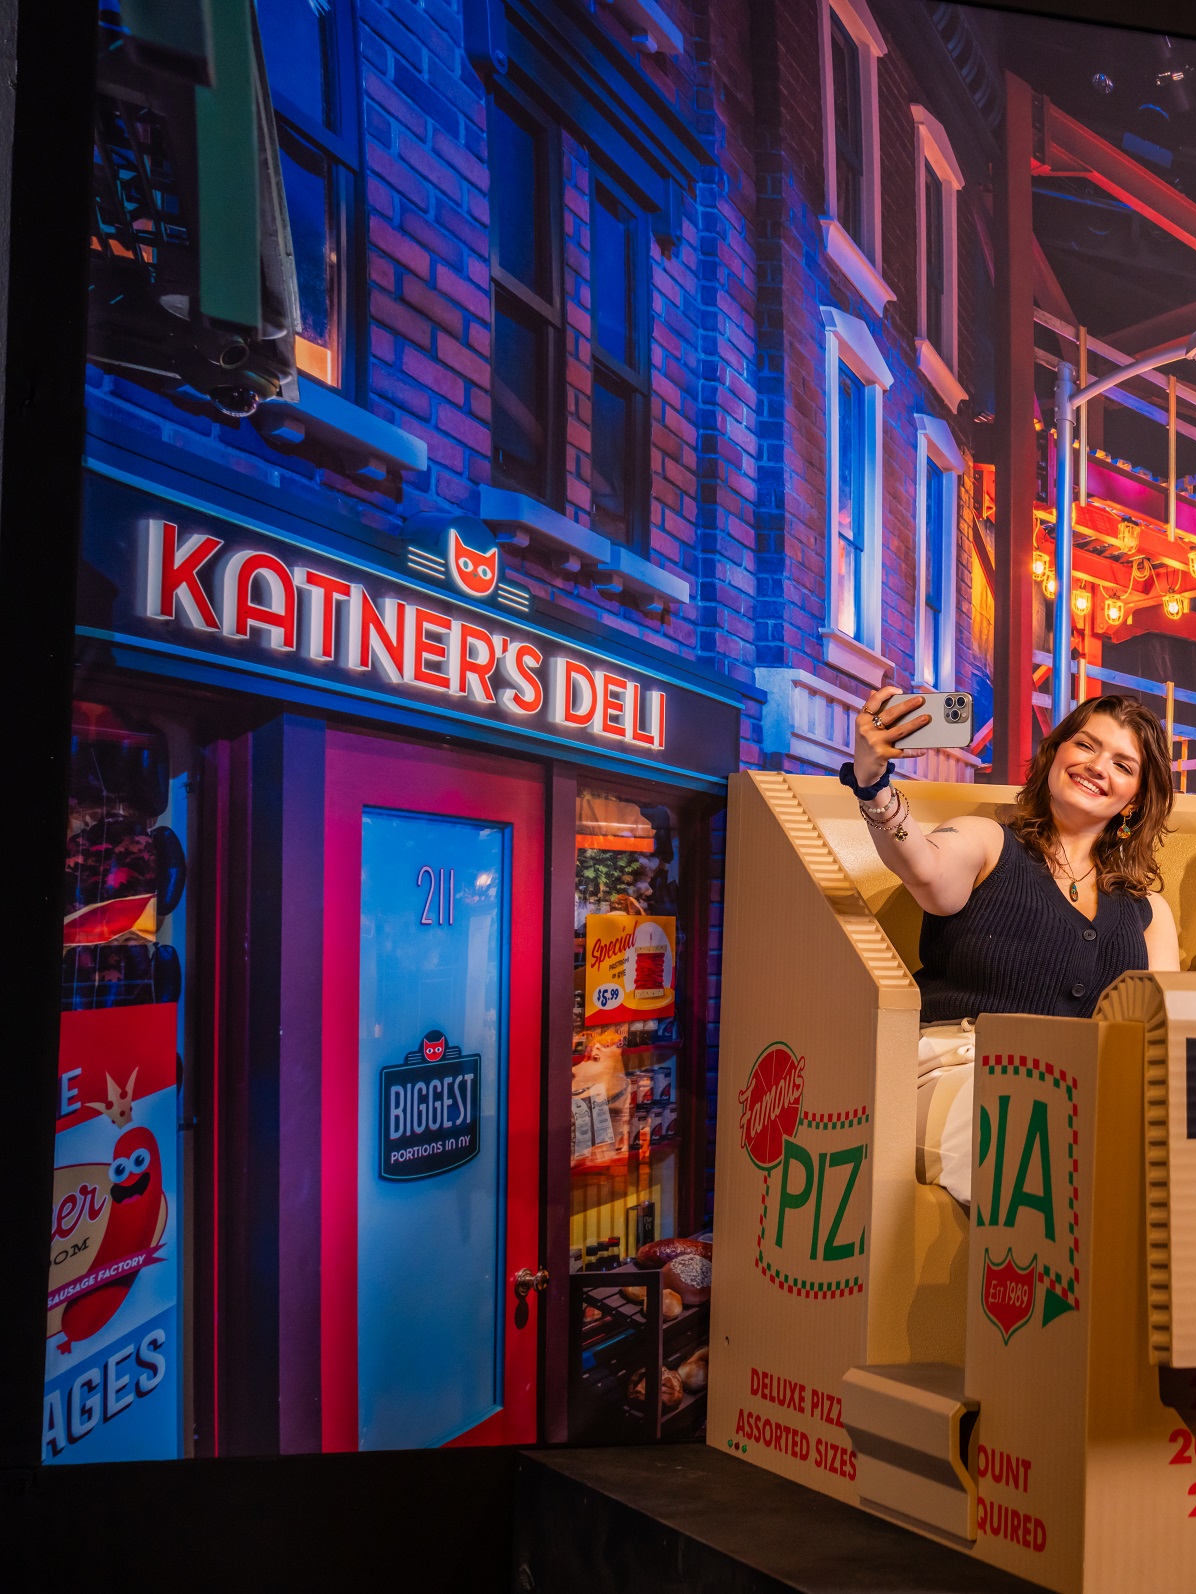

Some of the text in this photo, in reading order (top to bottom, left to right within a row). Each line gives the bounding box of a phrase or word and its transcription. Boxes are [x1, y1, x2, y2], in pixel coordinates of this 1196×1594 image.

[593, 447, 680, 476] 10000 LBS MAX
[147, 518, 667, 750] KATNER'S DELI
[416, 865, 454, 925] 211
[590, 920, 638, 972] Special
[597, 988, 619, 1007] $5.99
[390, 1073, 474, 1140] BIGGEST
[738, 1056, 805, 1149] Famous
[52, 1183, 108, 1242] er
[52, 1237, 90, 1266] OM
[47, 1254, 146, 1307] SAUSAGE FACTORY
[1005, 1280, 1029, 1308] 1989
[750, 1367, 806, 1414] DELUXE
[736, 1408, 857, 1481] ASSORTED SIZES
[977, 1444, 1031, 1493] OUNT
[977, 1496, 1047, 1552] QUIRED
